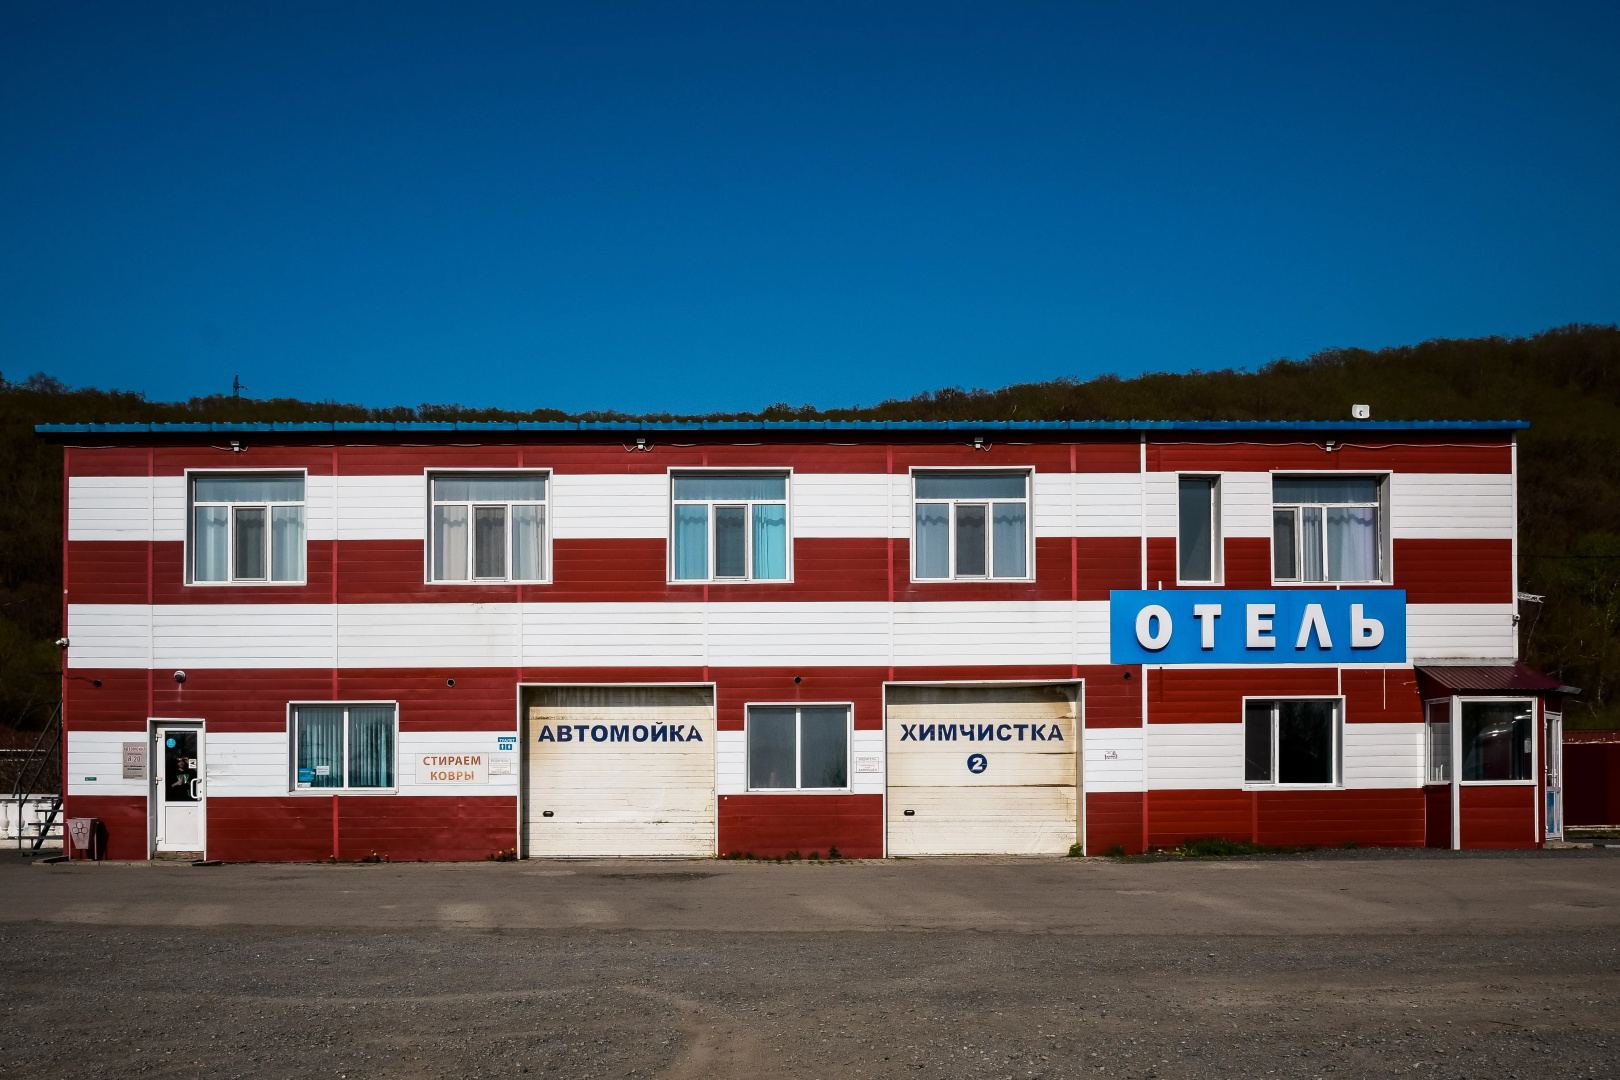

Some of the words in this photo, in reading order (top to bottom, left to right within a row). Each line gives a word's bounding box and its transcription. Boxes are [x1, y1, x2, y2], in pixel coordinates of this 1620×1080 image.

[1135, 603, 1385, 650] ОТЕЛЬ
[538, 722, 703, 743] АВТОМОЙКА
[900, 723, 1064, 741] ХИМЧИСТКА
[423, 756, 481, 766] СТИРАЕМ
[972, 757, 983, 770] 2
[430, 770, 474, 781] КОВРЫ
